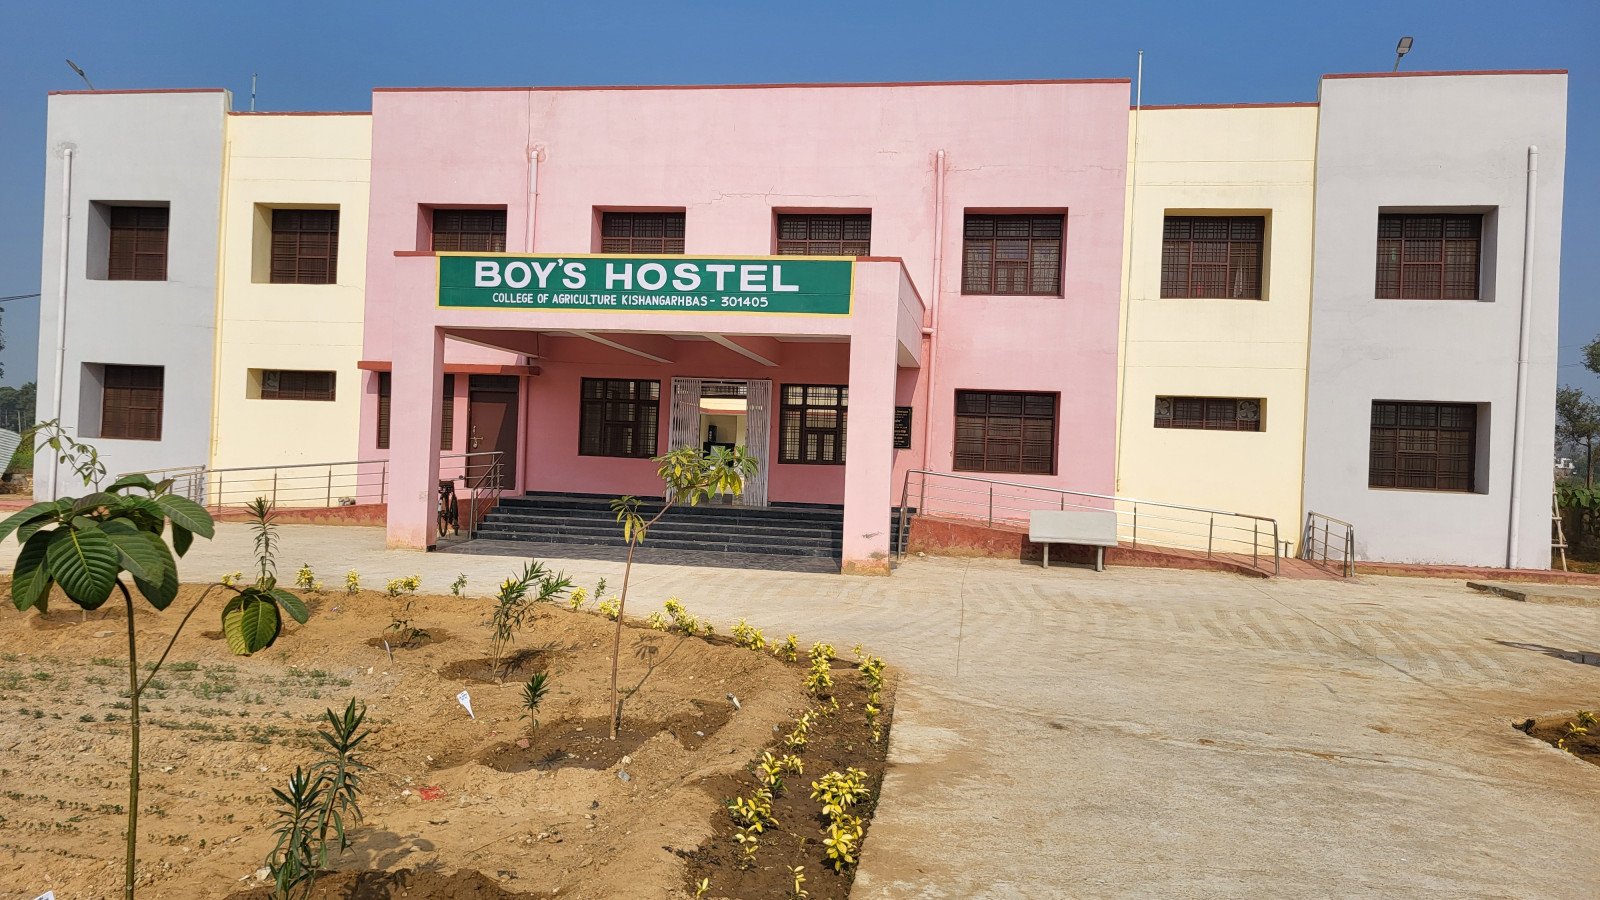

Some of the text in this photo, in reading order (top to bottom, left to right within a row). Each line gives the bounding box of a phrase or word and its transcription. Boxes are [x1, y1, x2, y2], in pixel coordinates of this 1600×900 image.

[474, 259, 800, 292] BOY'S HOSTEL
[492, 293, 534, 304] COLLEGE
[537, 294, 549, 304] OF
[552, 294, 617, 305] AGRICULTURE
[721, 296, 769, 308] 301405
